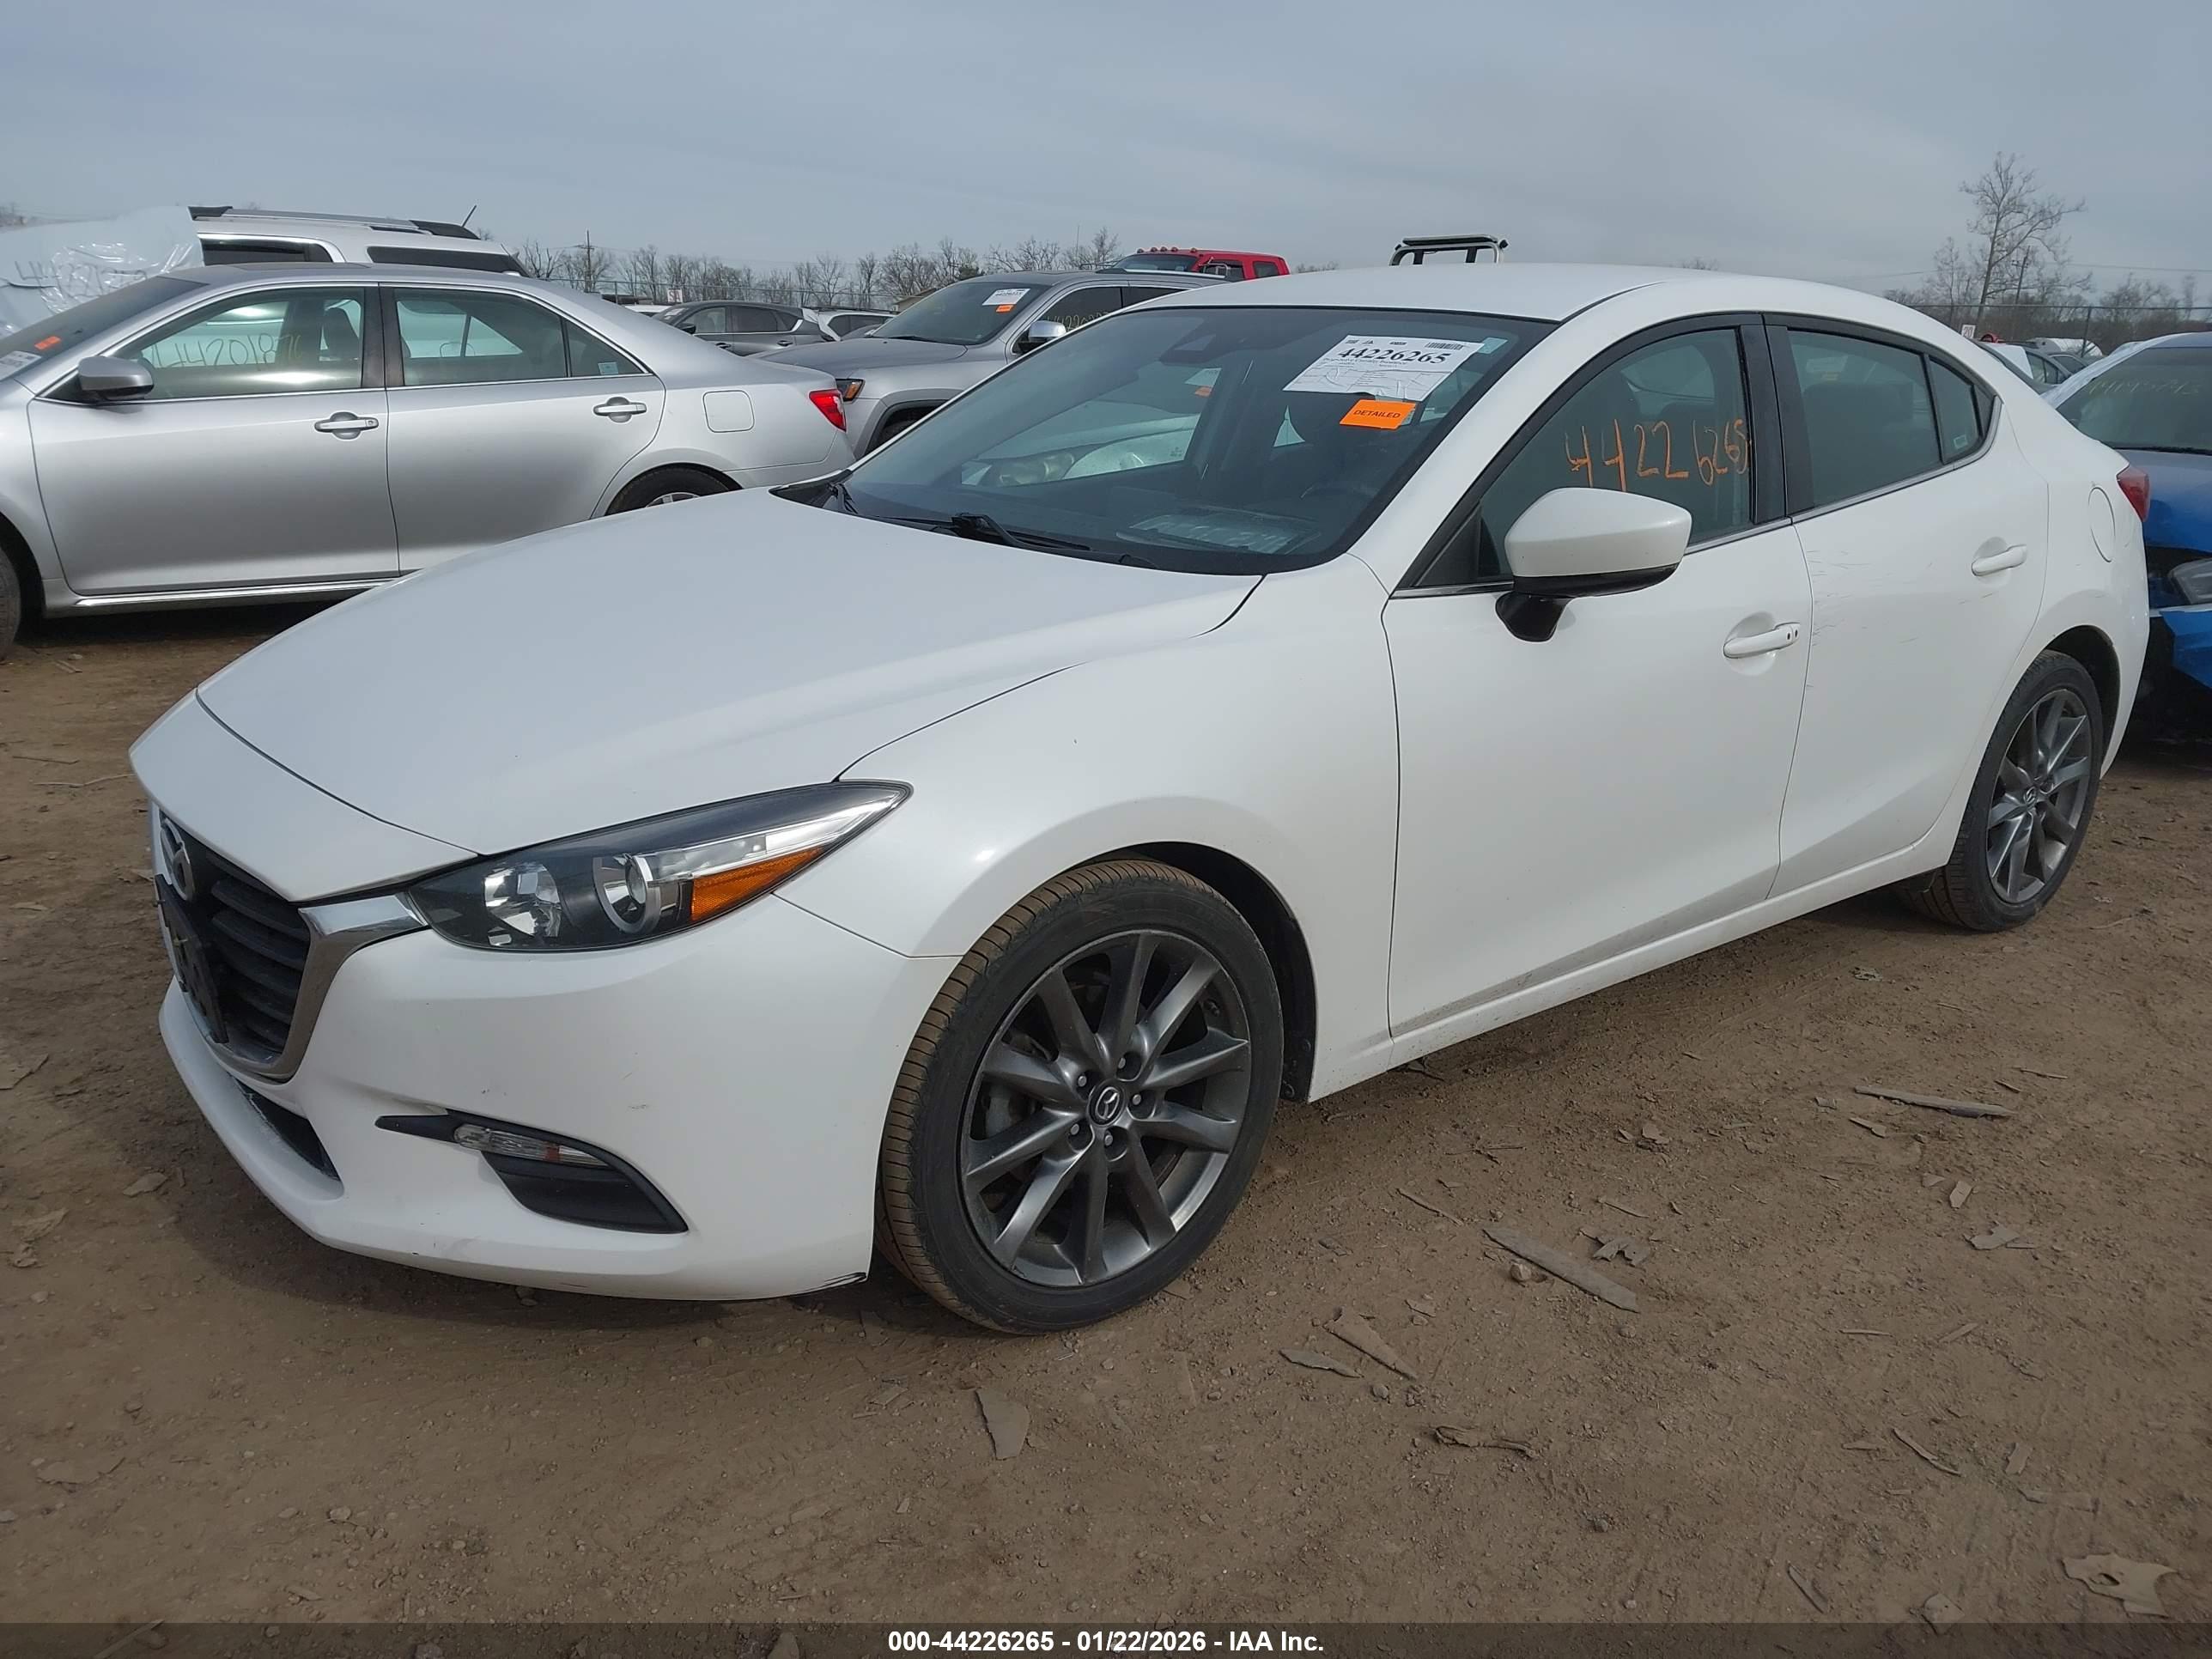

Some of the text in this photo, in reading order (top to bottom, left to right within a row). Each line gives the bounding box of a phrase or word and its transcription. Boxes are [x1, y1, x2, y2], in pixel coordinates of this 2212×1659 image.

[1337, 348, 1451, 364] 44226265
[1352, 409, 1401, 419] DETAILED
[1565, 418, 1749, 492] 44226265
